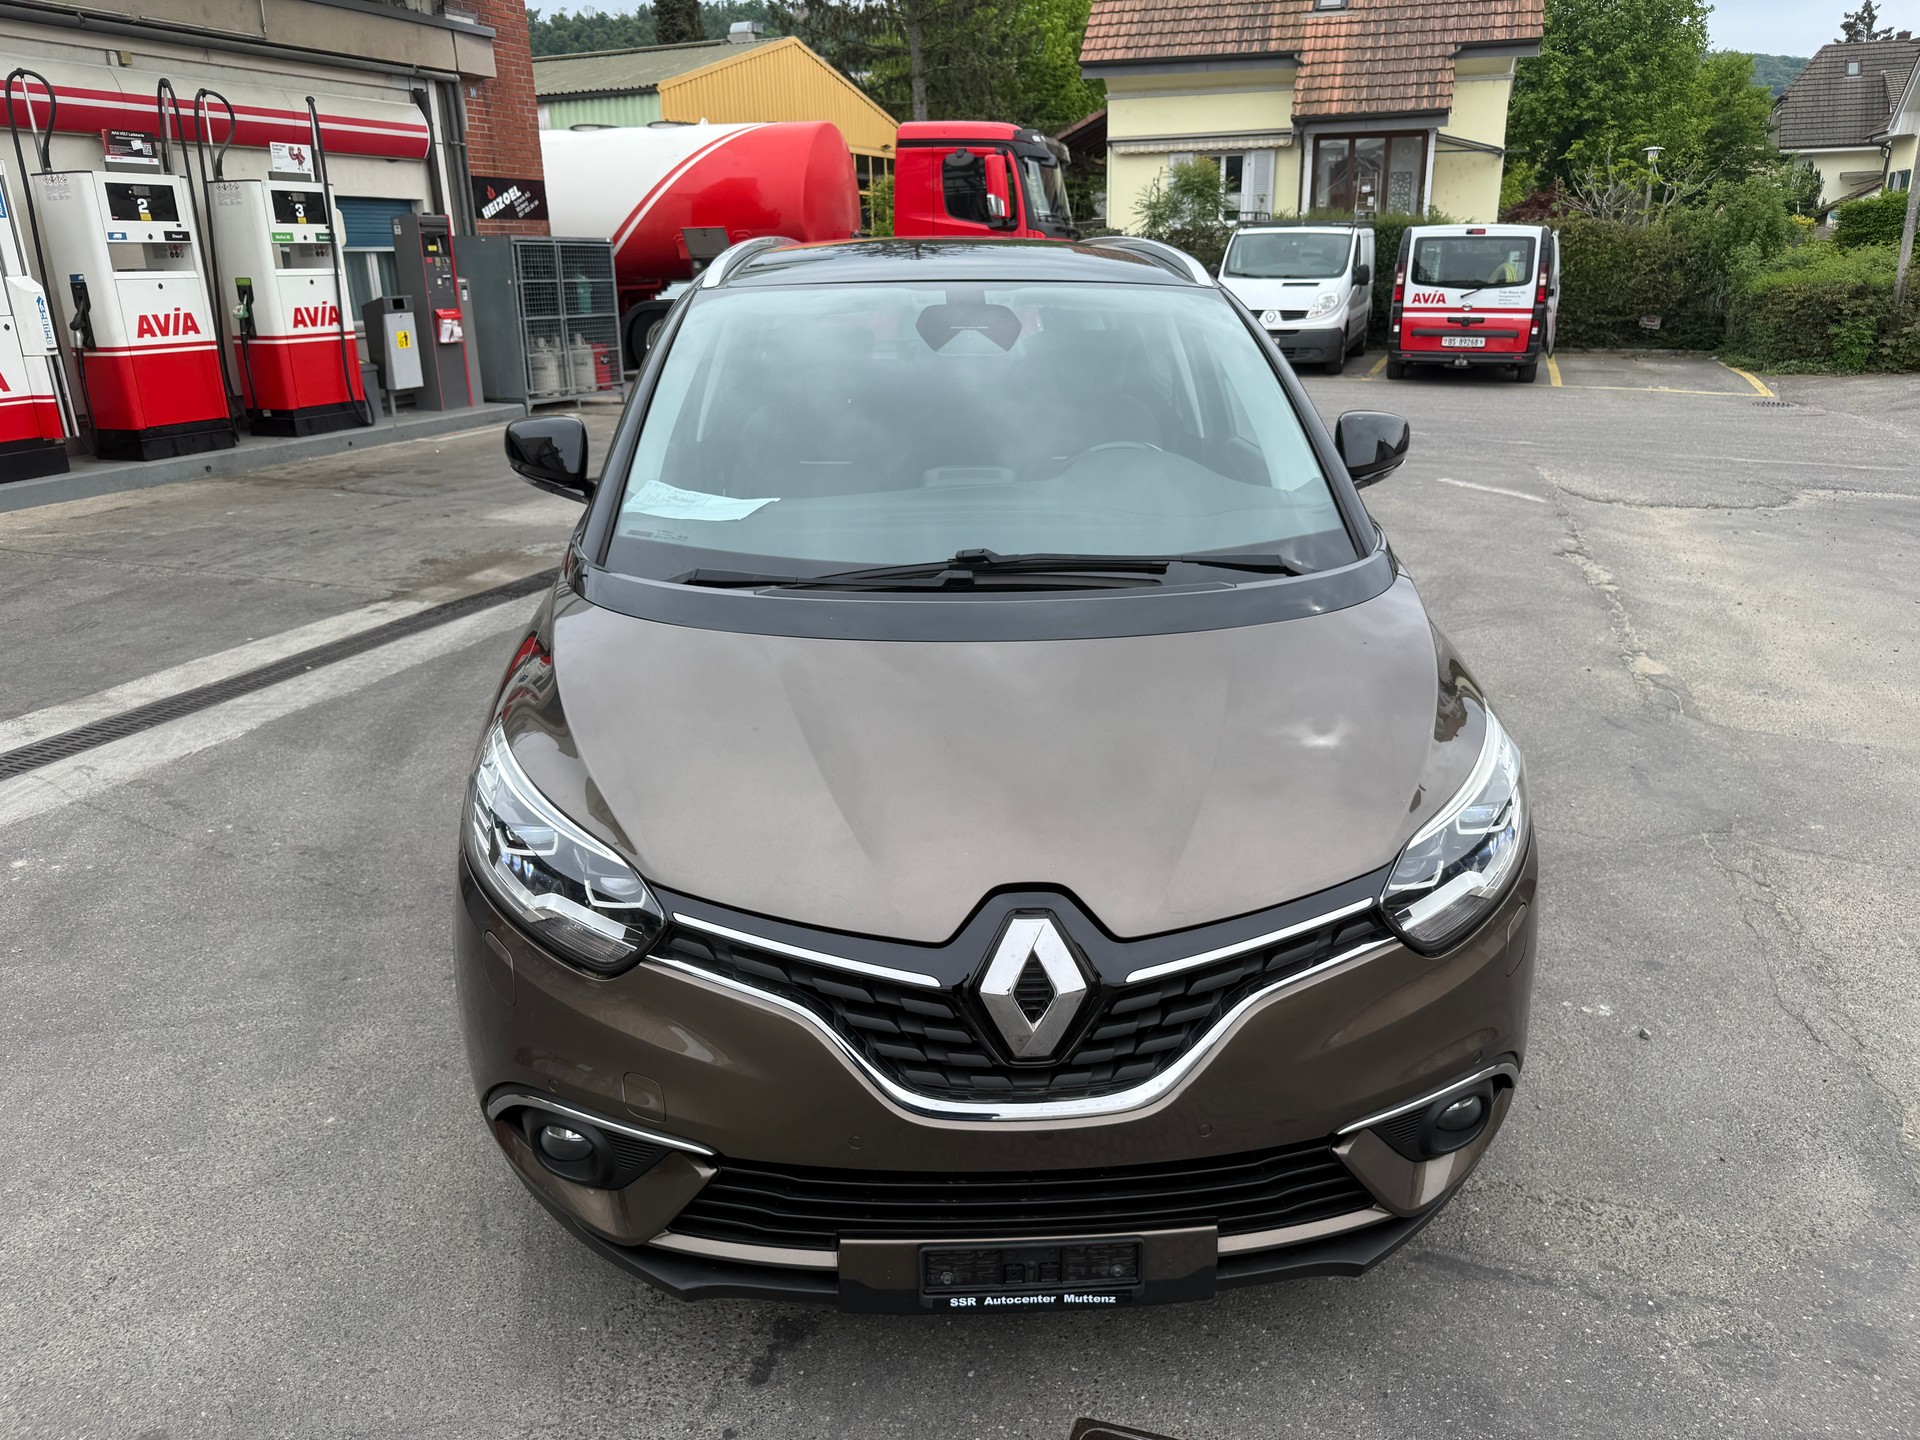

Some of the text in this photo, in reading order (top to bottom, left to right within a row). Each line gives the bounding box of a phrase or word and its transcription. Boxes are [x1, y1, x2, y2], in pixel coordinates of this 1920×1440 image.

[137, 198, 150, 213] 2
[481, 185, 522, 219] HEIZOEL
[295, 203, 305, 217] 3
[1411, 290, 1447, 304] AVIA
[293, 300, 341, 329] AVIA
[137, 307, 202, 338] AVIA
[1448, 338, 1456, 346] BS
[950, 1294, 1117, 1307] SSR Autocenter Muttenz
